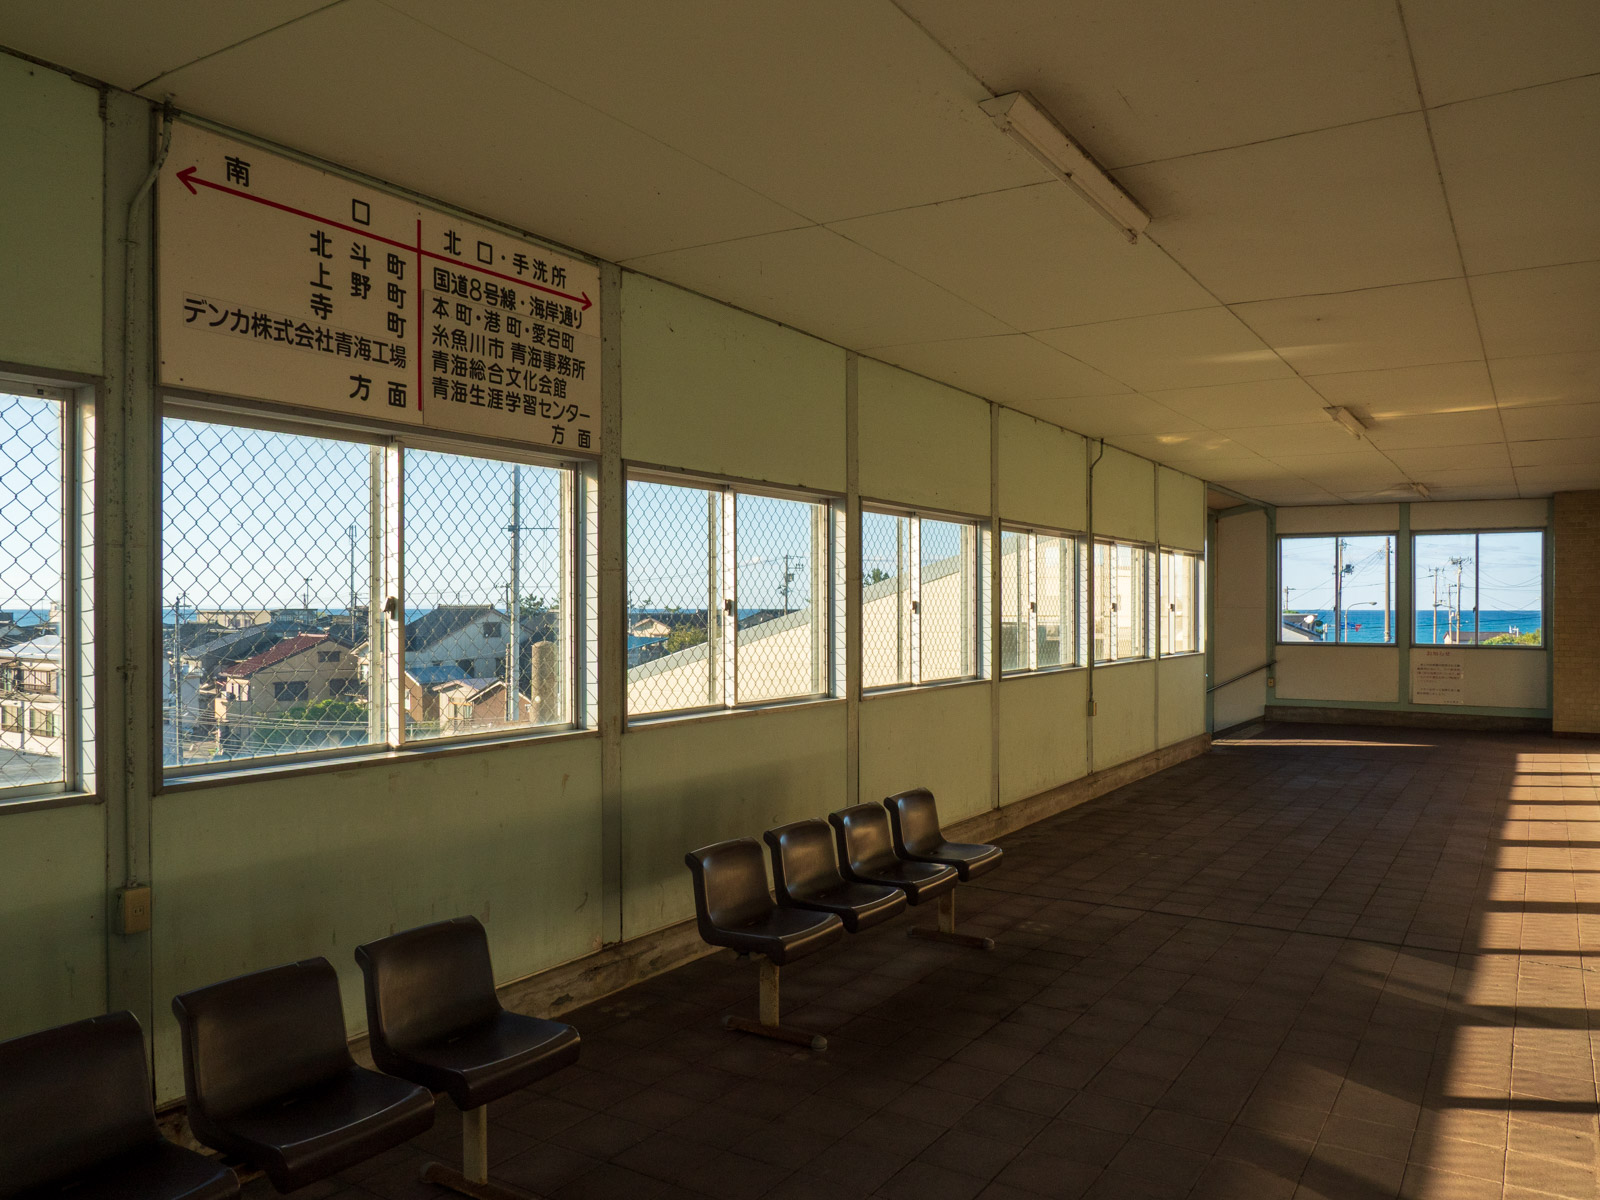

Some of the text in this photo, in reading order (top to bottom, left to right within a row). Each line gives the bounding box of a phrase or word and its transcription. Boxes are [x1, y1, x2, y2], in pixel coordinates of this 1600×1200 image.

[310, 230, 407, 281] 北斗町
[443, 230, 567, 289] 北口・手洗所
[310, 262, 407, 309] 上野町
[433, 267, 583, 330] 国道8号線・海岸通り
[184, 298, 407, 369] デンカ株式会社青海工場
[310, 293, 407, 339] 寺町
[349, 374, 407, 408] 方面
[432, 350, 567, 399] 青海総合文化会館
[432, 376, 591, 423] 青海生涯学習センター
[552, 424, 591, 449] 方面
